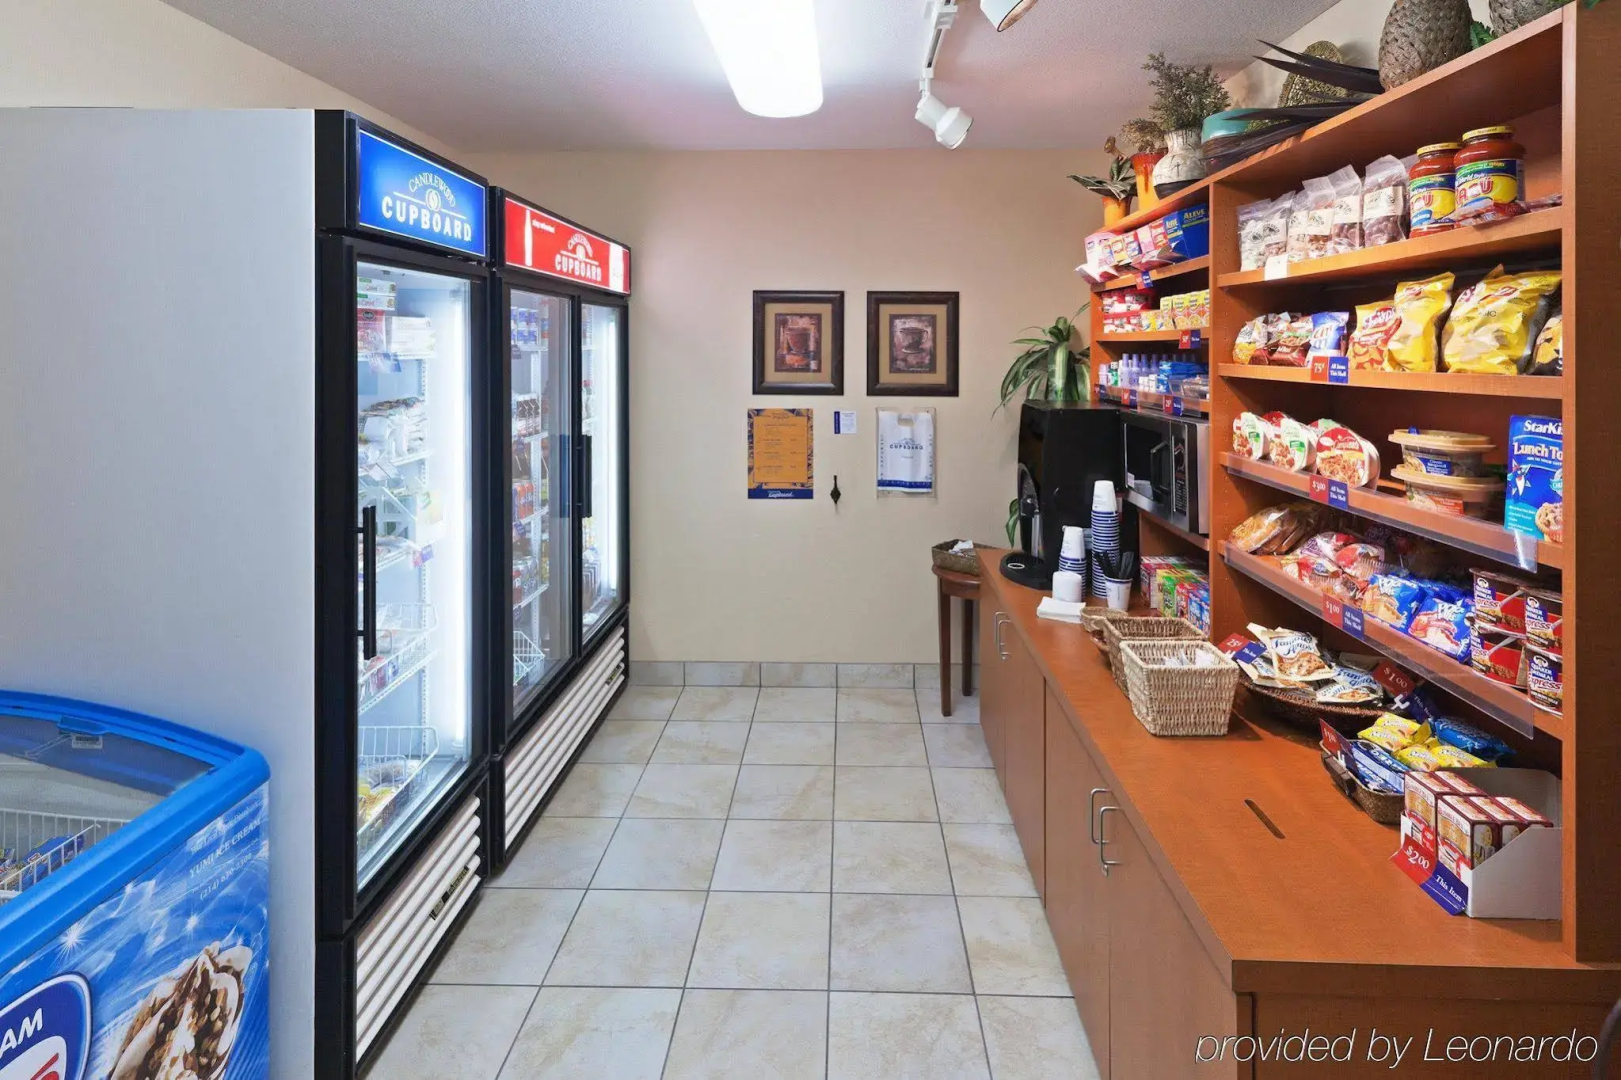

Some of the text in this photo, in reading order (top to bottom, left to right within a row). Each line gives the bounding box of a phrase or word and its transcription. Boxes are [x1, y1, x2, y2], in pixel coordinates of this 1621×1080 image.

[382, 196, 472, 241] CUPBOARD
[555, 254, 602, 282] CUPBOARD
[1523, 420, 1563, 436] StarKi
[1512, 441, 1549, 458] Lunch
[1531, 662, 1553, 675] QUAKER
[215, 842, 231, 859] ICE
[231, 818, 261, 845] CREAM
[1406, 845, 1430, 869] $200
[1436, 874, 1462, 903] This Item
